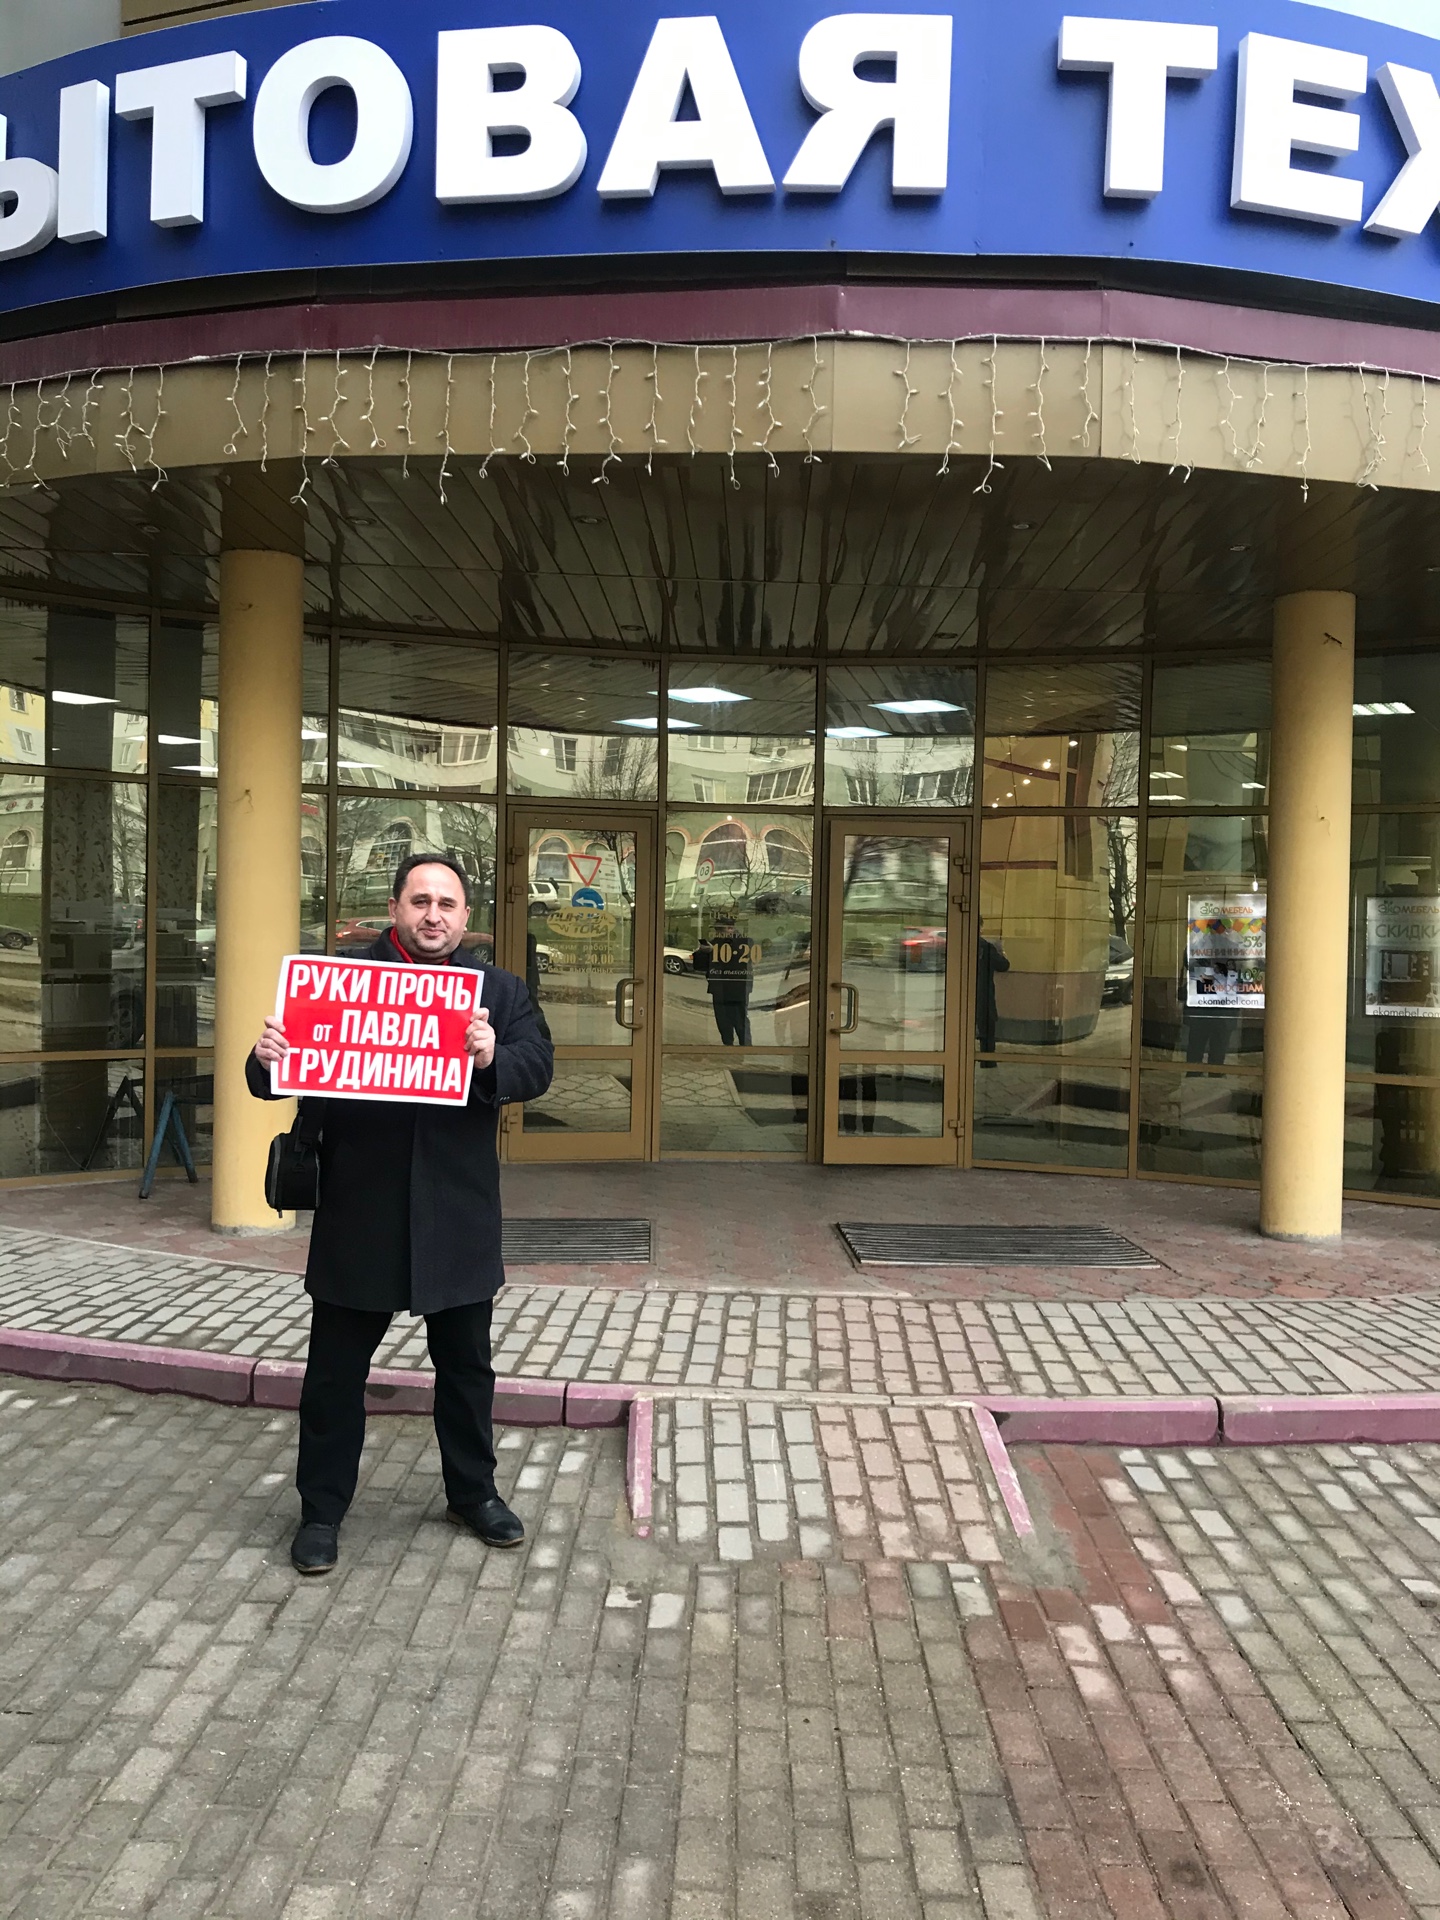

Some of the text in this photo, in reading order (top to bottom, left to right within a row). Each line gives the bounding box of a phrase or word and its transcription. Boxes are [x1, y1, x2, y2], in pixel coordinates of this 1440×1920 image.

[290, 964, 472, 1011] РУКИ ПРОЧЬ
[1197, 996, 1259, 1006] ekomebel.com
[1203, 983, 1264, 993] НОВОСЕЛАМ
[339, 1008, 441, 1050] ПАВЛА
[280, 1047, 462, 1093] ГРУДИНИНА
